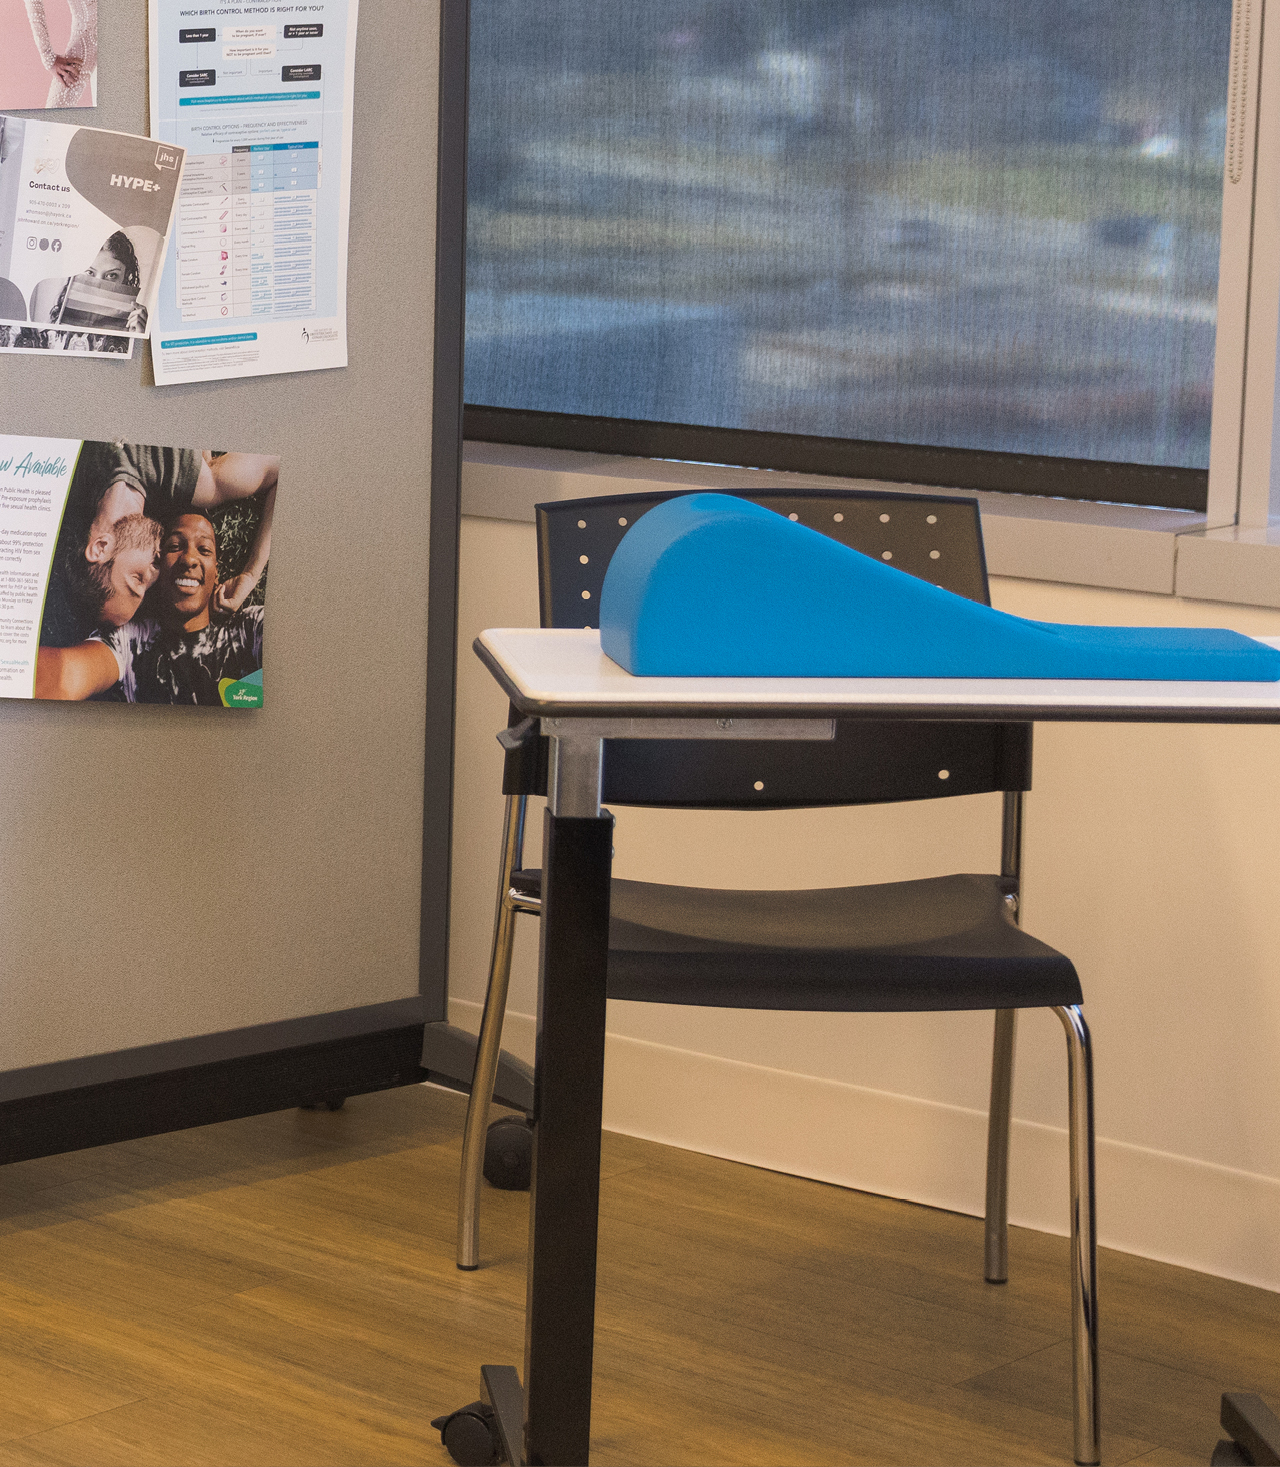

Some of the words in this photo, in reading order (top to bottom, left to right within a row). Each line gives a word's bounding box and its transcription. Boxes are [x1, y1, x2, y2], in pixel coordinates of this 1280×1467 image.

[159, 153, 174, 163] jhs
[29, 181, 60, 191] Contact
[110, 174, 161, 192] HYPE+
[14, 452, 67, 478] Available
[35, 489, 51, 497] pleased
[1, 495, 27, 503] Pre-exposure
